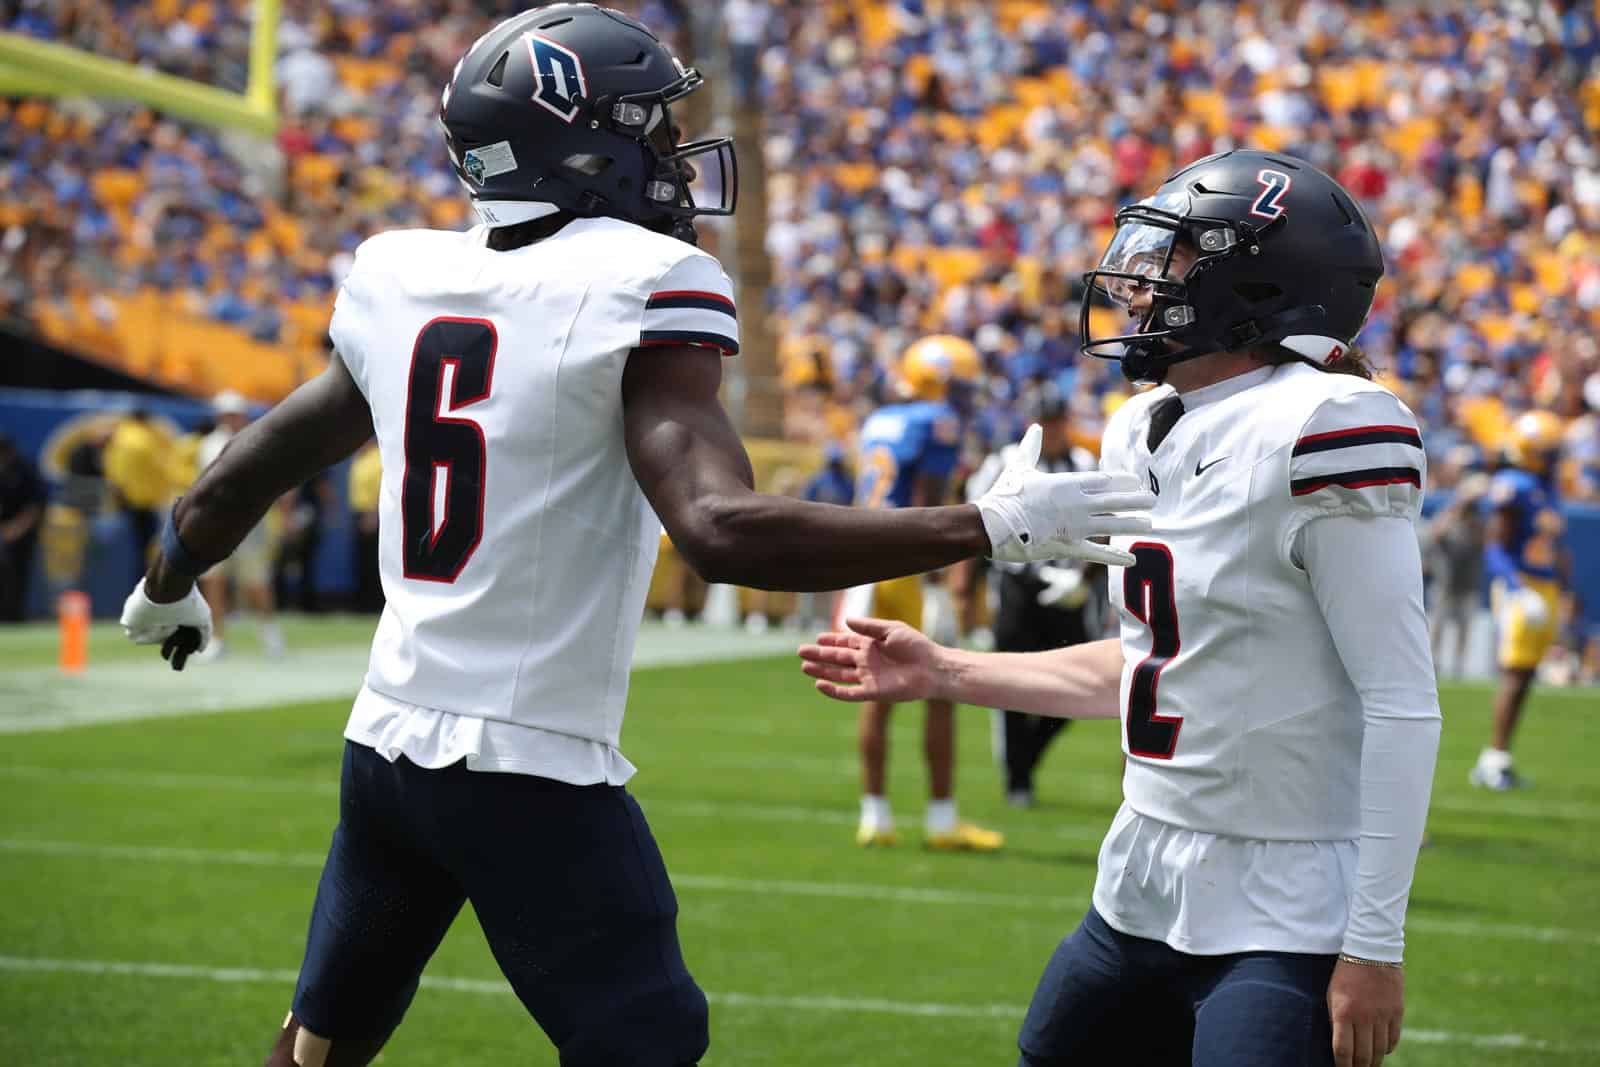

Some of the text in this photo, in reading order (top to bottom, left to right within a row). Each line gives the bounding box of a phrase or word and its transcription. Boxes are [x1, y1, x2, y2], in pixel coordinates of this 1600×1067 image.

[1250, 169, 1291, 220] 2
[402, 316, 498, 584] 6
[1123, 542, 1184, 760] 2
